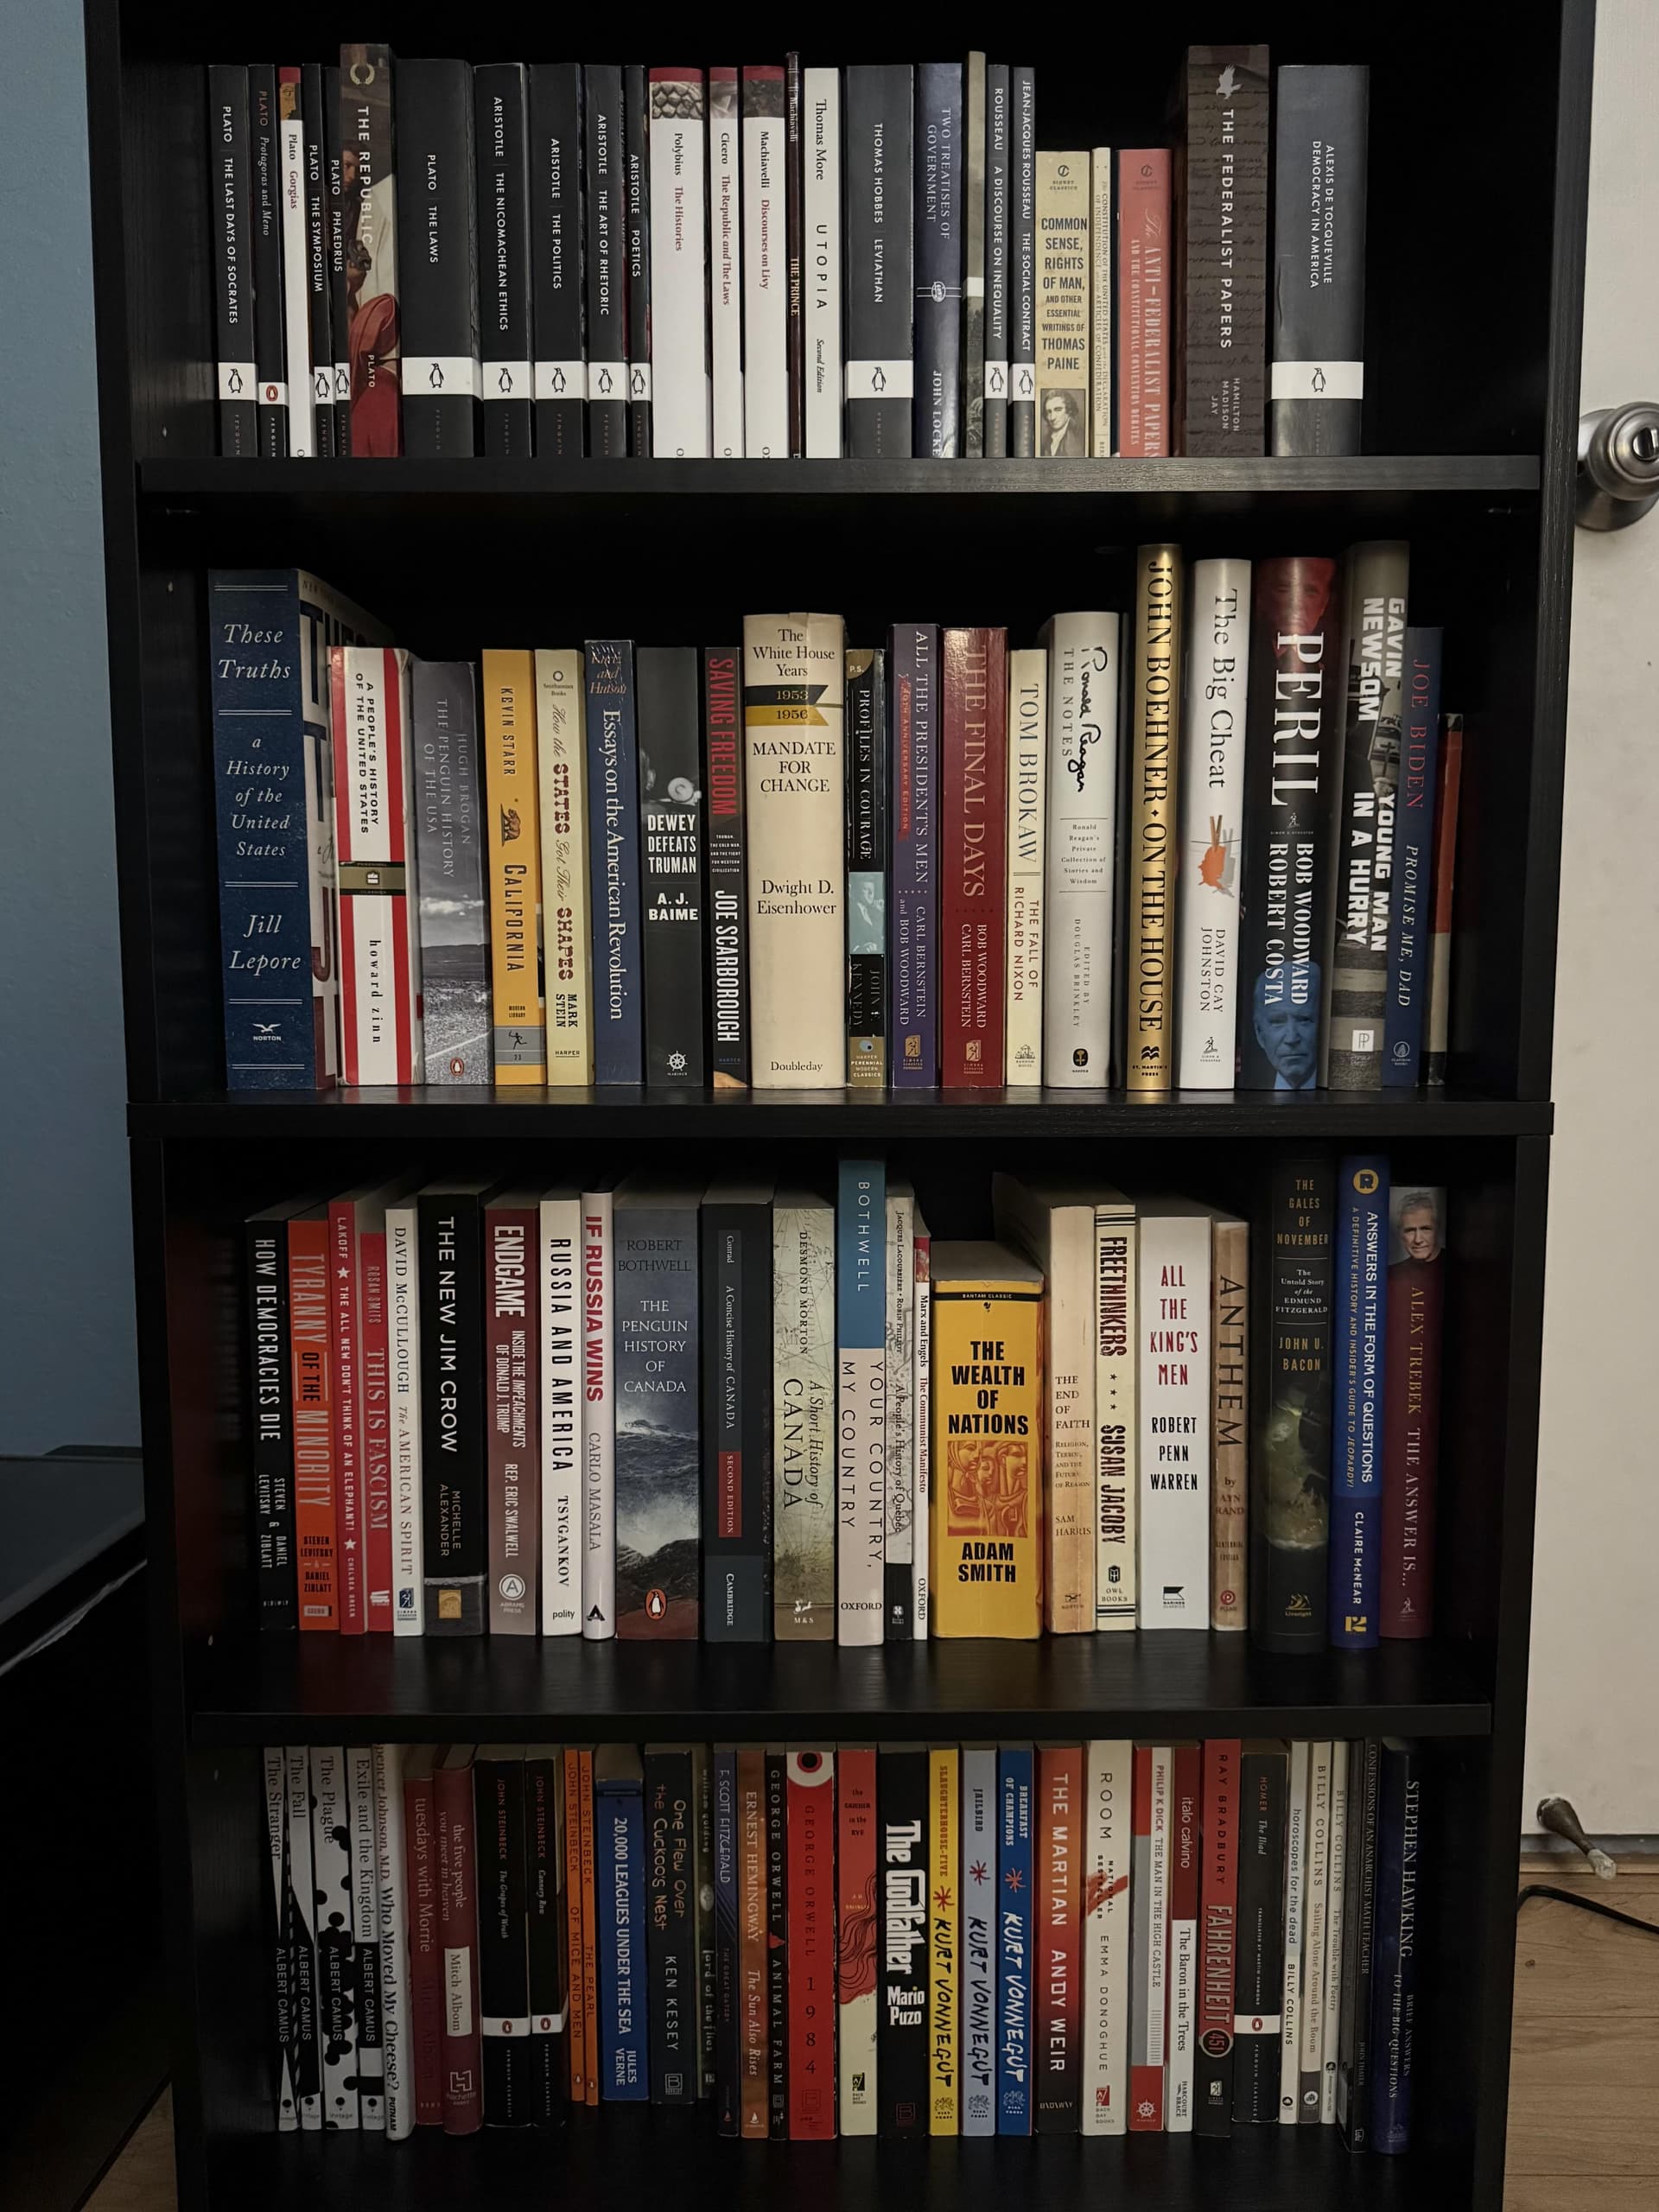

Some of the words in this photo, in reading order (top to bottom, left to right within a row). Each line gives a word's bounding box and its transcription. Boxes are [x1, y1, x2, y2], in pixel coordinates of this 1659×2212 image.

[222, 105, 232, 142] PLATO
[815, 98, 827, 145] Thomas
[1222, 108, 1234, 143] THE
[288, 133, 297, 160] Plato
[760, 130, 770, 188] Machiavelli
[874, 123, 883, 173] THOMAS
[224, 157, 233, 178] THE
[816, 149, 827, 180] More
[1311, 140, 1321, 214] DEMOCRACY
[1325, 144, 1334, 183] ALEXIS
[225, 182, 234, 209] LAST
[287, 170, 298, 209] Gorgias
[874, 177, 883, 223] HOBBES
[1325, 188, 1333, 202] DE
[1040, 217, 1087, 230] COMMON
[1220, 154, 1233, 268] FEDERALIST
[1311, 218, 1319, 231] IN
[226, 213, 235, 242] DAYS
[760, 199, 770, 252] Discourses
[226, 245, 236, 261] OF
[1045, 237, 1083, 251] SENSE,
[1323, 206, 1333, 283] TOCQUEVILLE
[760, 253, 767, 267] on
[816, 224, 828, 308] UTOPIA
[874, 238, 883, 302] LEVIATHAN
[1044, 257, 1084, 270] RIGHTS
[1310, 235, 1319, 288] AMERICA
[759, 269, 770, 289] Livy
[1042, 276, 1056, 289] OF
[1058, 276, 1084, 290] MAN,
[226, 265, 238, 323] SOCRATES
[1045, 295, 1058, 303] AND
[1060, 295, 1082, 303] OTHER
[1220, 278, 1232, 347] PAPERS
[1041, 337, 1084, 350] THOMAS
[1047, 357, 1079, 370] PAINE
[1146, 561, 1172, 645] JOHN
[1213, 588, 1237, 644] The
[223, 623, 283, 643] These
[777, 628, 803, 641] The
[752, 645, 791, 658] White
[796, 645, 835, 659] House
[218, 658, 290, 679] Truths
[775, 663, 807, 676] Years
[1205, 657, 1235, 700] Big
[500, 688, 513, 726] KEVIN
[1271, 630, 1324, 805] PERIL
[251, 738, 261, 747] a
[1142, 655, 1170, 805] BOEHNER
[502, 734, 515, 774] STARR
[753, 741, 836, 755] MANDATE
[1208, 709, 1233, 788] Cheat
[226, 760, 289, 780] History
[779, 760, 810, 773] FOR
[235, 786, 254, 807] of
[257, 787, 282, 802] the
[760, 778, 830, 791] CHANGE
[232, 814, 290, 829] United
[647, 814, 696, 830] DEWEY
[236, 840, 285, 856] States
[647, 835, 696, 852] DEFEATS
[1141, 822, 1166, 864] ON
[647, 856, 696, 873] TRUMAN
[657, 892, 671, 905] A.
[674, 892, 689, 905] J.
[761, 879, 811, 897] Dwight
[818, 879, 834, 893] D.
[1141, 869, 1165, 930] THE
[504, 864, 527, 971] CALIFORNIA
[648, 908, 697, 920] BAIME
[756, 899, 836, 914] Eisenhower
[242, 914, 282, 938] Jill
[228, 950, 301, 976] Lepore
[369, 939, 383, 997] howard
[1139, 934, 1164, 1032] HOUSE
[371, 1007, 383, 1042] zinn
[770, 1060, 823, 1071] Doubleday
[438, 1216, 454, 1261] THE
[726, 1235, 734, 1263] Conrad
[255, 1239, 276, 1275] HOW
[550, 1238, 572, 1313] RUSSIA
[1160, 1264, 1185, 1287] ALL
[438, 1270, 455, 1325] NEW
[639, 1300, 669, 1312] THE
[1099, 1236, 1127, 1356] FREETHINKERS
[1159, 1298, 1186, 1319] THE
[621, 1319, 688, 1332] PENGUIN
[256, 1285, 280, 1404] DEMOCRACIES
[439, 1333, 456, 1370] JIM
[550, 1325, 572, 1363] AND
[624, 1339, 686, 1351] HISTORY
[969, 1340, 1004, 1360] THE
[1150, 1331, 1198, 1352] KING'S
[645, 1360, 665, 1372] OF
[1158, 1363, 1187, 1385] MEN
[1217, 1274, 1246, 1446] ANTHEM
[1282, 1357, 1320, 1370] BACON
[624, 1380, 686, 1392] CANADA
[950, 1364, 1024, 1386] WEALTH
[976, 1389, 998, 1409] OF
[259, 1413, 280, 1440] DIE
[440, 1380, 457, 1452] CROW
[551, 1377, 573, 1471] AMERICA
[948, 1413, 1028, 1435] NATIONS
[1151, 1416, 1197, 1433] ROBERT
[1100, 1424, 1126, 1476] SUSAN
[1159, 1445, 1188, 1461] PENN
[1149, 1472, 1198, 1490] WARREN
[1100, 1484, 1125, 1543] JACOBY
[557, 1495, 569, 1586] TSYGANKOV
[1353, 1511, 1363, 1554] CLAIRE
[961, 1541, 1014, 1560] ADAM
[957, 1563, 1015, 1582] SMITH
[1352, 1557, 1362, 1604] McNEAR
[551, 1609, 575, 1620] polity
[840, 1601, 882, 1610] OXFORD
[1052, 1773, 1068, 1814] THE
[1099, 1772, 1112, 1839] ROOM
[1181, 1796, 1193, 1823] italo
[613, 1817, 628, 1859] 20,000
[886, 1820, 920, 1862] The
[1180, 1827, 1192, 1868] calvino
[1051, 1826, 1068, 1925] MARTIAN
[615, 1864, 629, 1924] LEAGUES
[886, 1869, 925, 1974] Godfather
[616, 1928, 630, 1974] UNDER
[933, 1917, 952, 1974] KURT
[1179, 1927, 1191, 1950] The
[664, 1955, 677, 1987] KEN
[1051, 1949, 1066, 2006] ANDY
[1178, 1953, 1191, 1985] Baron
[1203, 1904, 1232, 2023] FAHRENHEIT
[617, 1978, 631, 2005] THE
[1287, 1963, 1295, 1993] BILLY
[887, 1985, 925, 2005] Mario
[1178, 1988, 1190, 1999] in
[617, 2008, 631, 2034] SEA
[889, 2005, 921, 2025] Puzo
[1178, 2001, 1189, 2018] the
[1285, 1998, 1294, 2044] COLLINS
[665, 1998, 678, 2050] KESEY
[931, 1979, 954, 2087] VONNEGUT
[1177, 2020, 1189, 2050] Trees
[1049, 2018, 1065, 2070] WEIR
